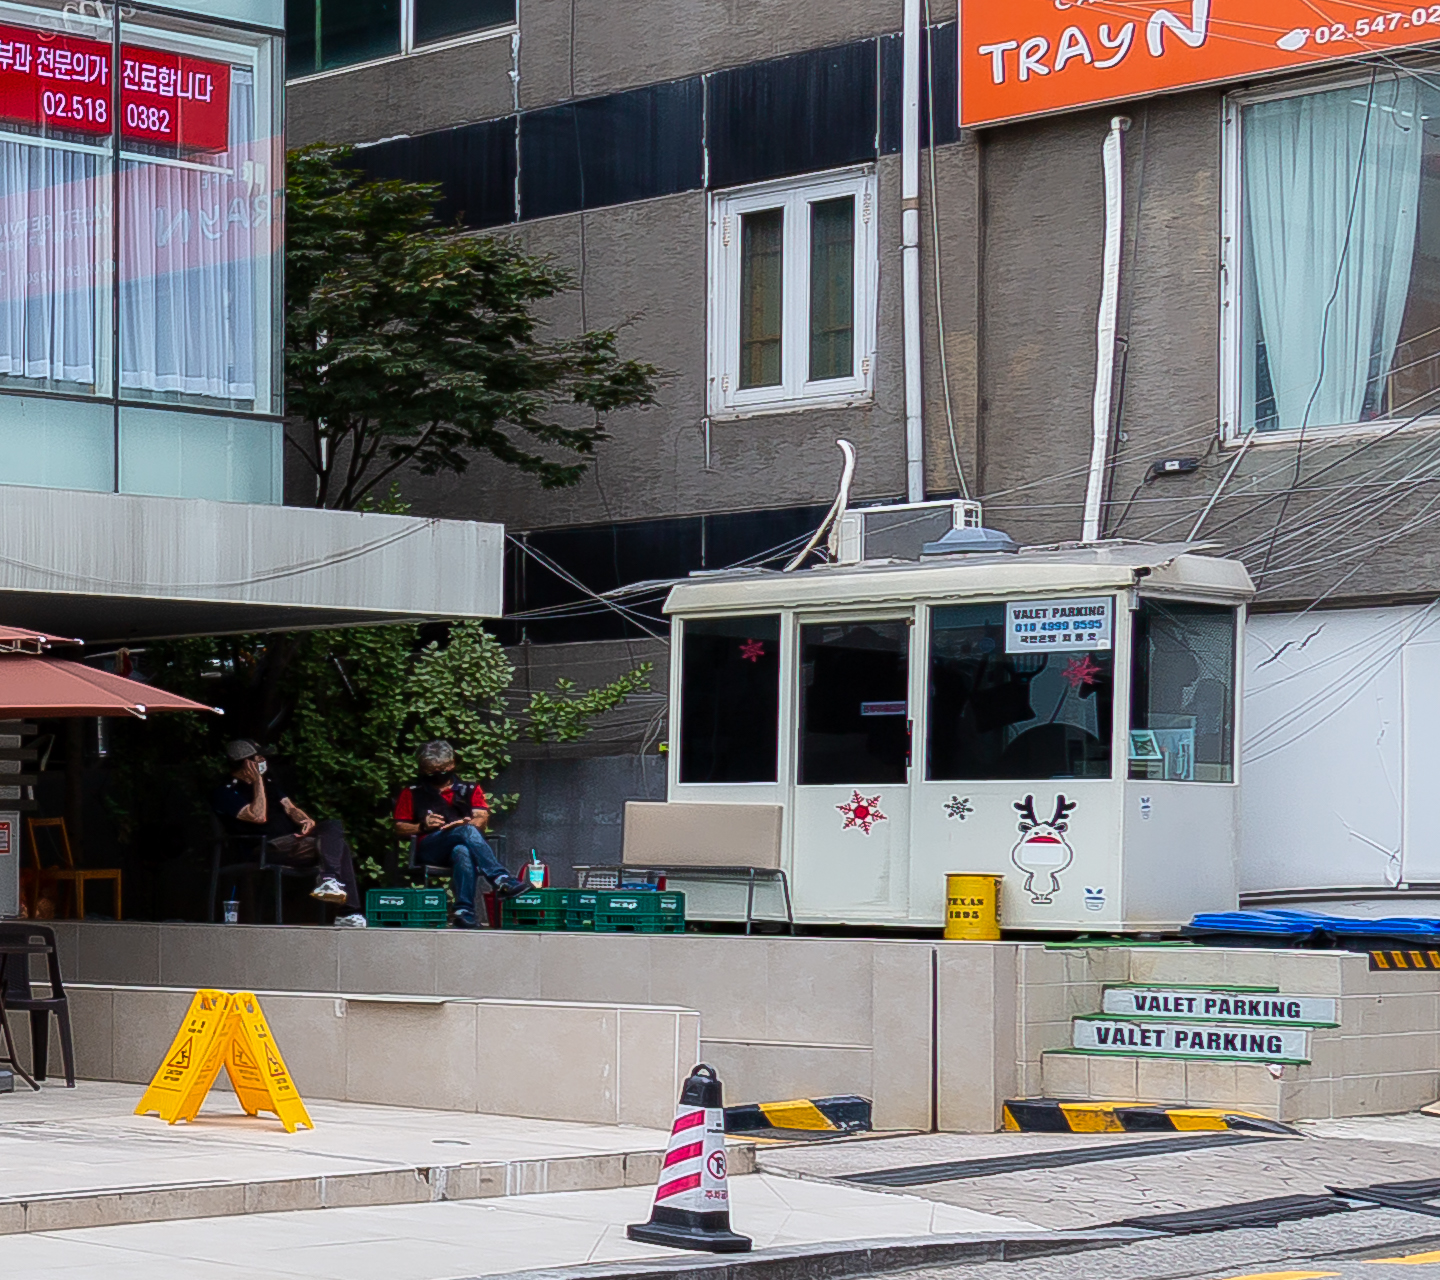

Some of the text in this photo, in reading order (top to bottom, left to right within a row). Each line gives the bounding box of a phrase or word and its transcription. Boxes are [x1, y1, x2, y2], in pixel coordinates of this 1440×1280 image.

[35, 46, 108, 85] 전문의가
[122, 58, 213, 103] 진료합니다
[42, 91, 171, 135] 02.518 0382
[1013, 605, 1105, 620] VALET PARKING
[1133, 994, 1301, 1019] VALET PARKING
[1095, 1026, 1283, 1055] VALET PARKING
